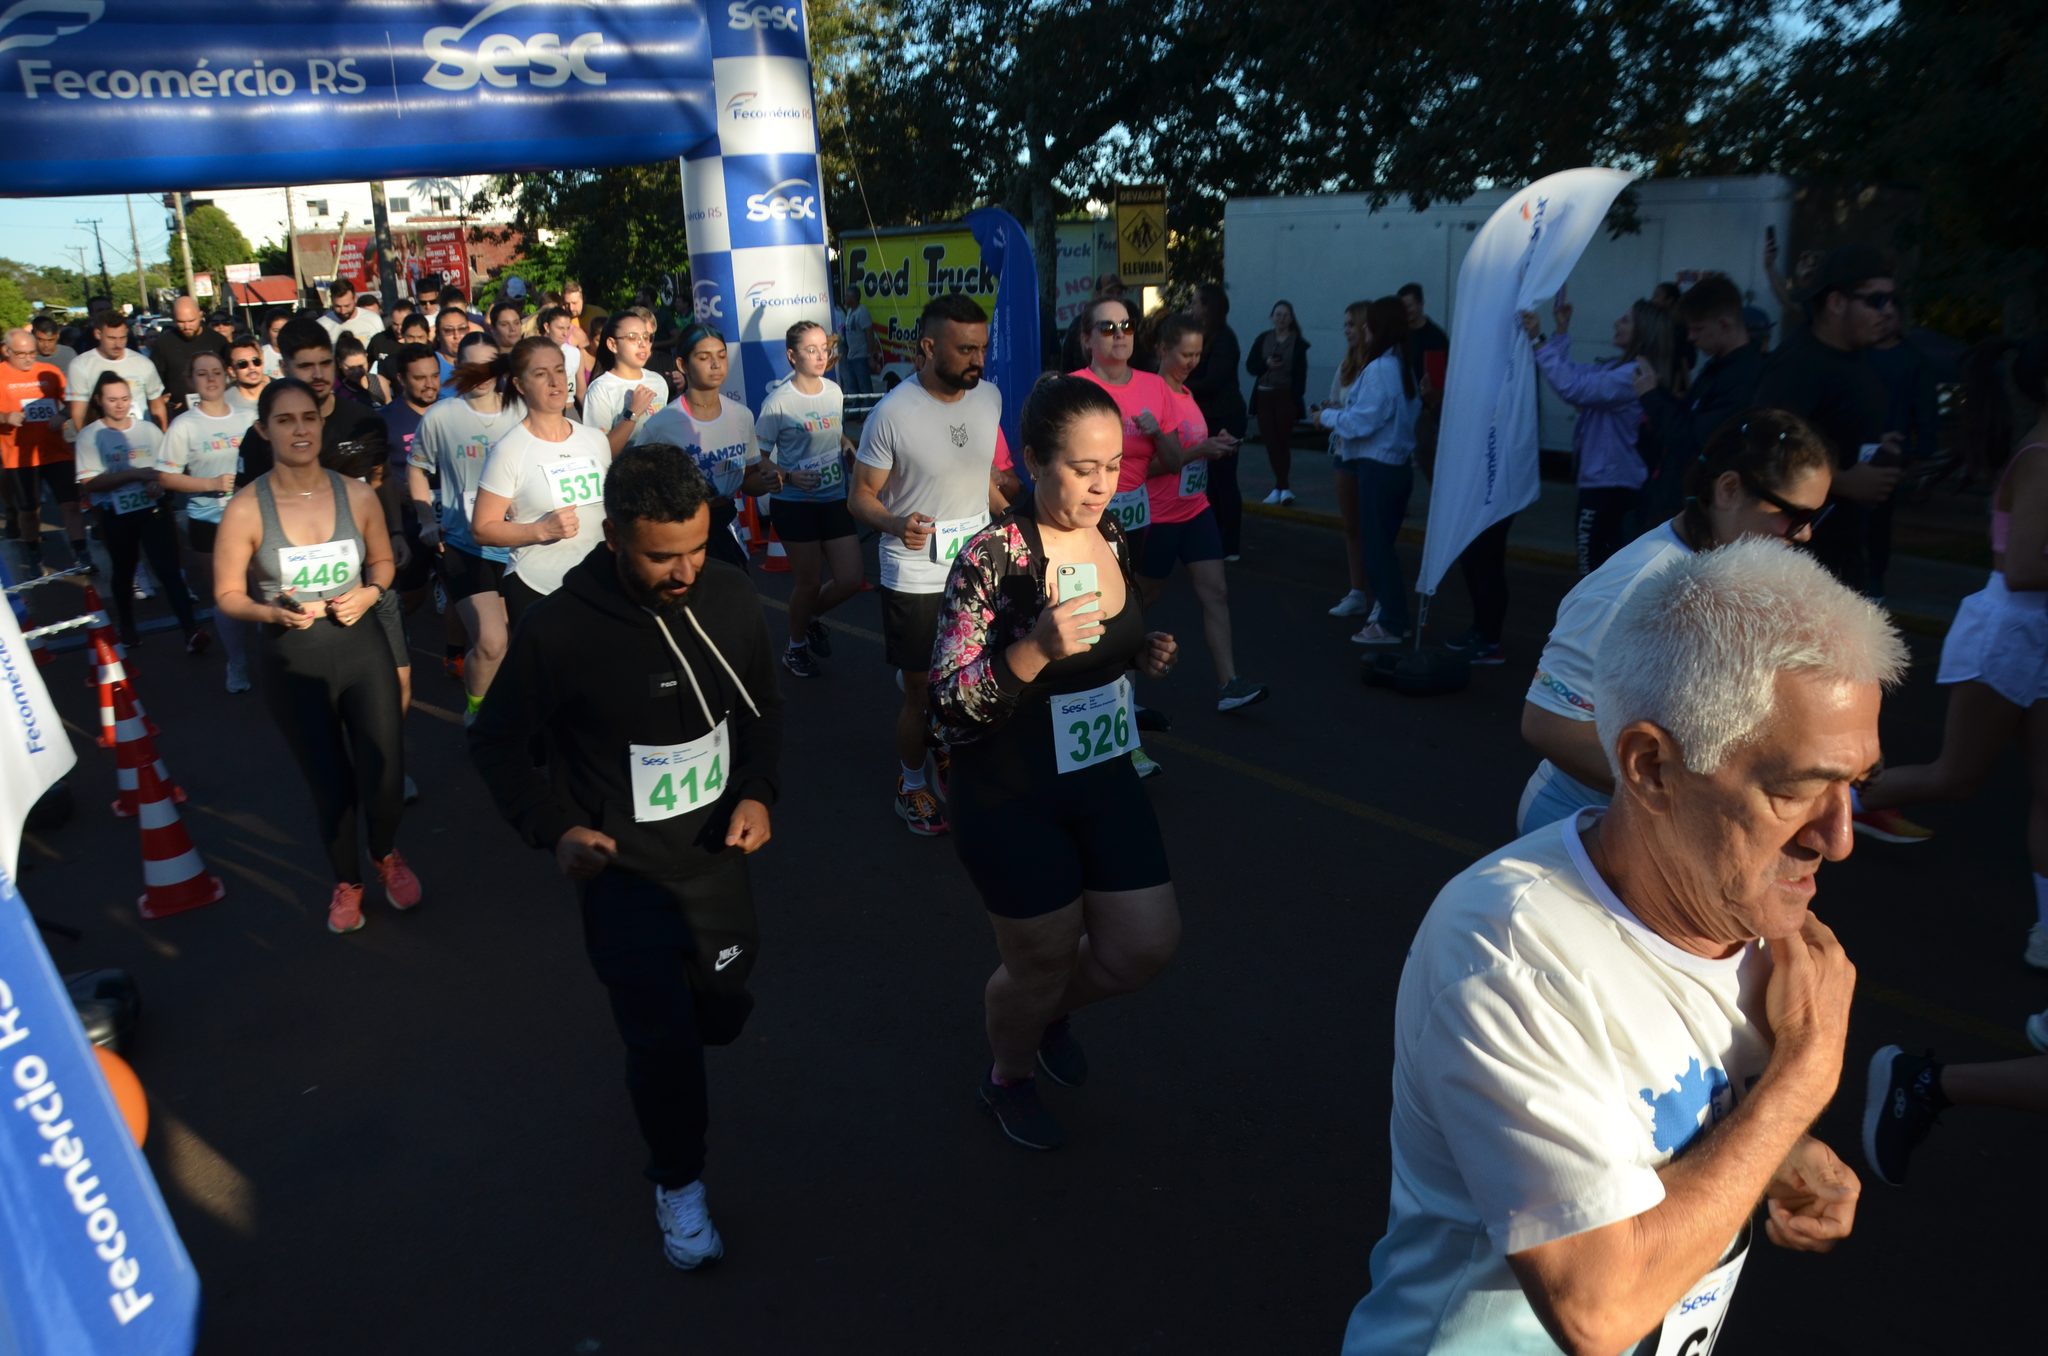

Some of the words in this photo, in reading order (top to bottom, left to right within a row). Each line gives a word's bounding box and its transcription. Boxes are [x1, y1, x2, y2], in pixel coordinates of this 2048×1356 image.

[18, 57, 296, 100] Fecomércio
[307, 57, 367, 96] RS
[733, 107, 801, 120] Fecomércio
[801, 108, 812, 119] RS
[1119, 189, 1162, 201] DEVAGAR
[707, 207, 722, 219] RS
[848, 247, 911, 298] Food
[923, 245, 995, 297] Truck
[1122, 261, 1164, 275] ELEVADA
[752, 294, 818, 309] Fecomércio
[818, 293, 829, 304] RS
[887, 316, 918, 342] Food
[28, 405, 54, 421] 689
[558, 472, 602, 504] 537
[291, 561, 350, 589] 446
[1068, 705, 1130, 763] 326
[649, 752, 723, 812] 414
[719, 944, 740, 960] NIKE
[12, 1053, 154, 1327] Fecomércio
